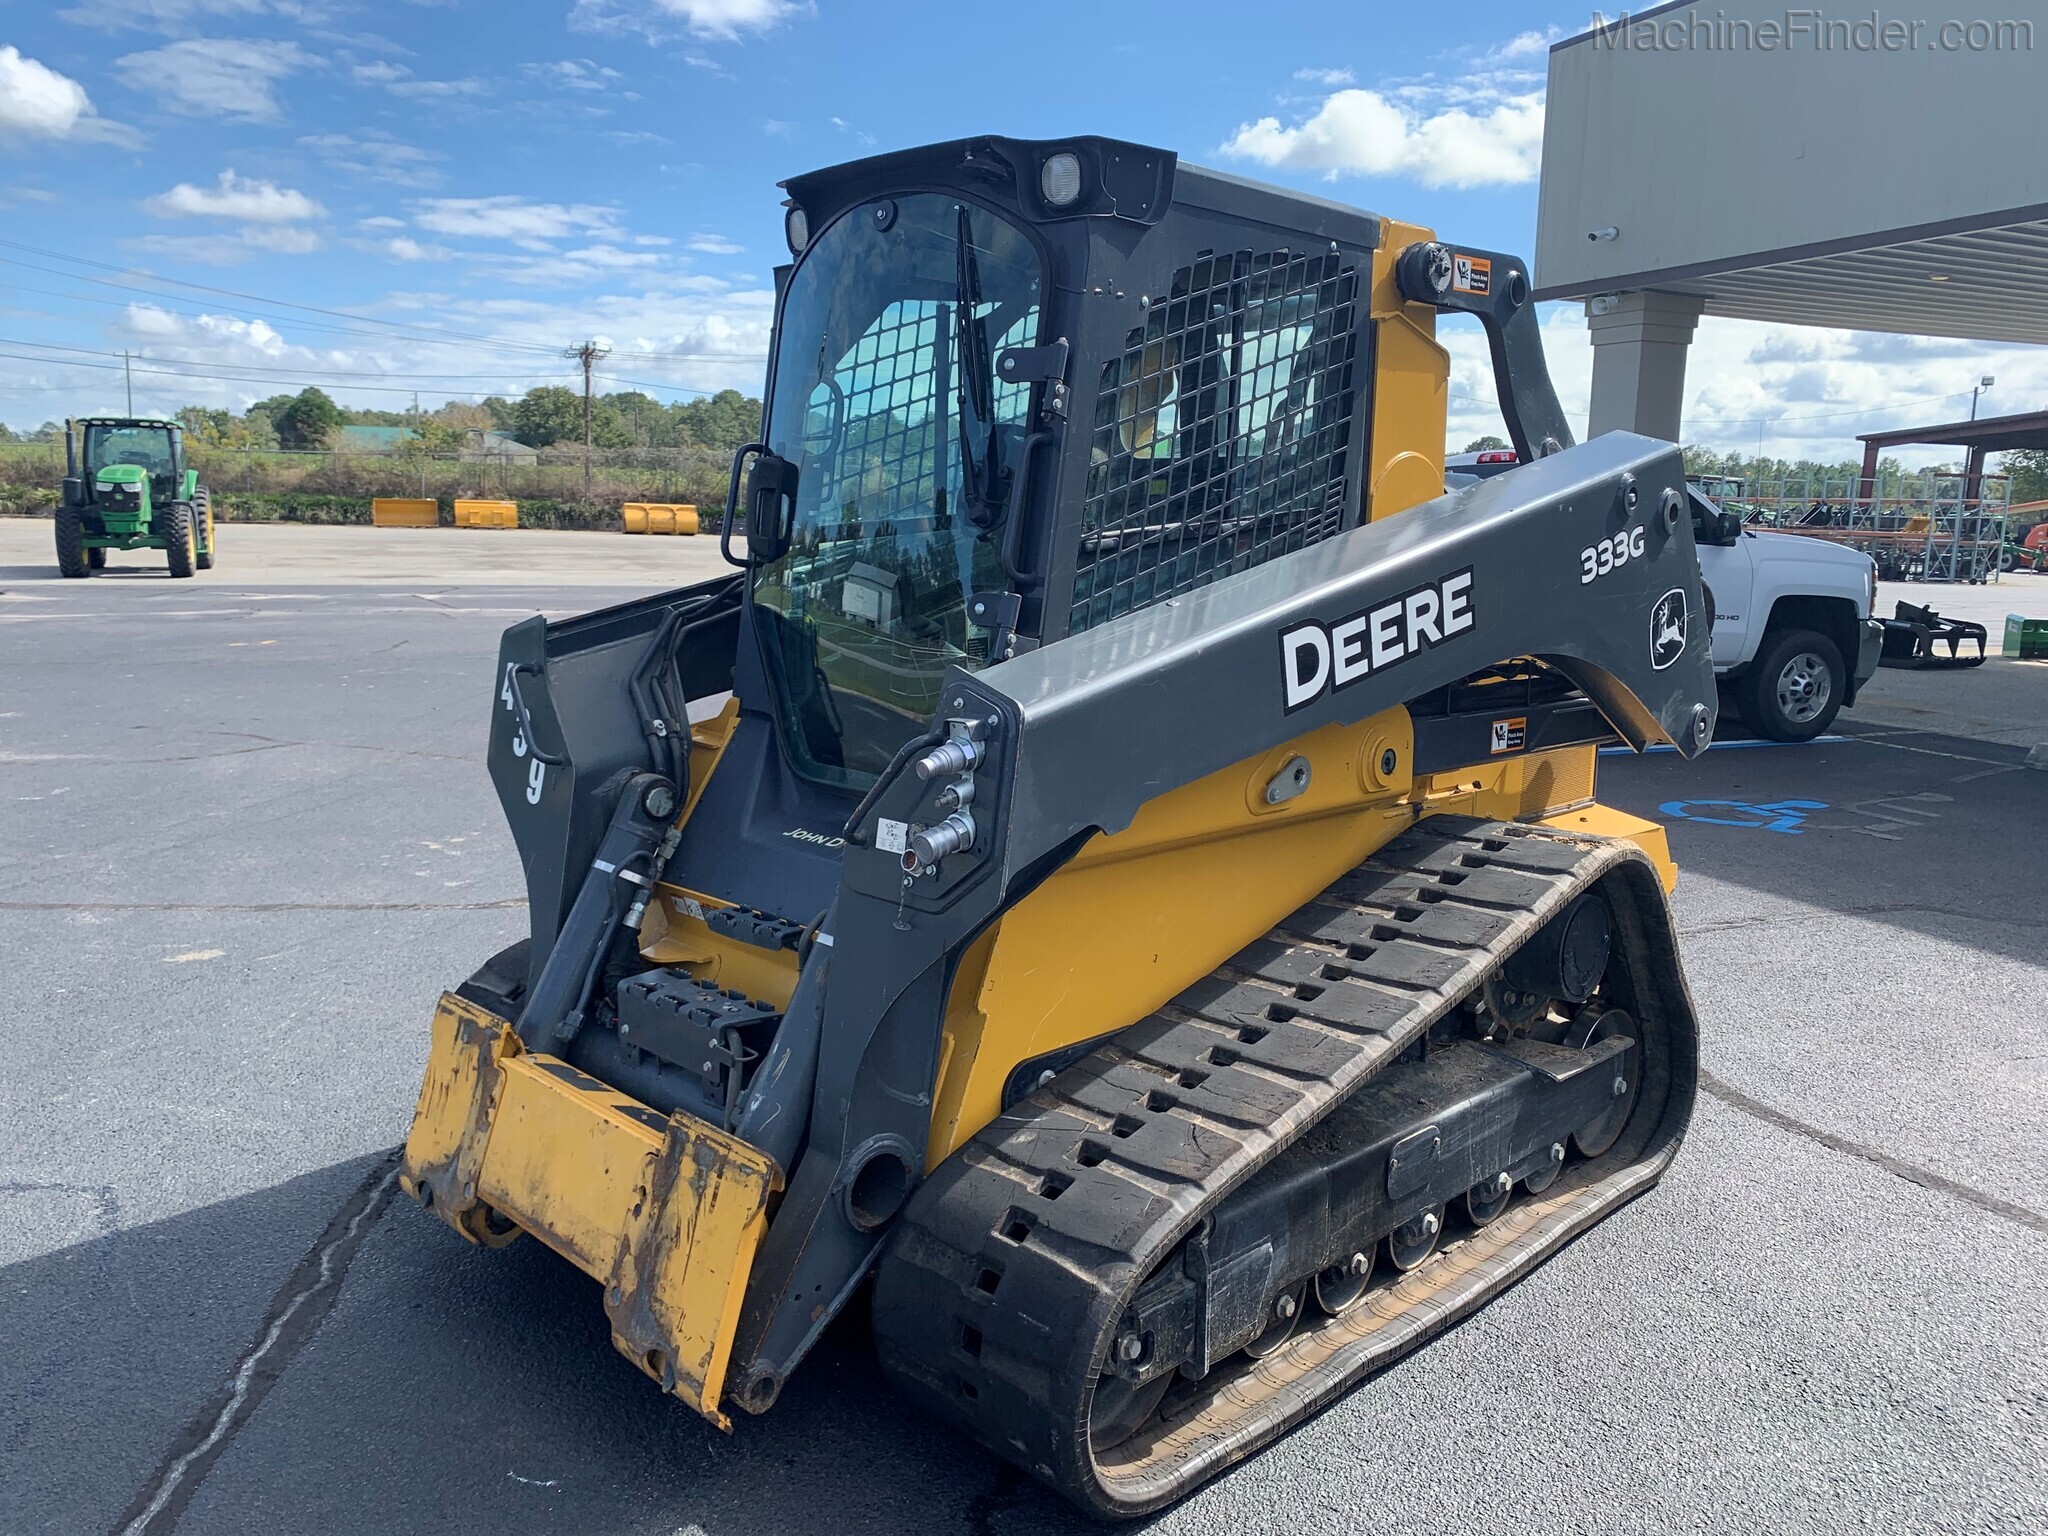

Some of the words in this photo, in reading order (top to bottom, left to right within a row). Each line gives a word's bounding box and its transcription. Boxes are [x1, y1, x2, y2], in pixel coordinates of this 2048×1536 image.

[1580, 525, 1645, 584] 333G
[1282, 571, 1473, 708] DEERE
[782, 828, 830, 844] JOHN
